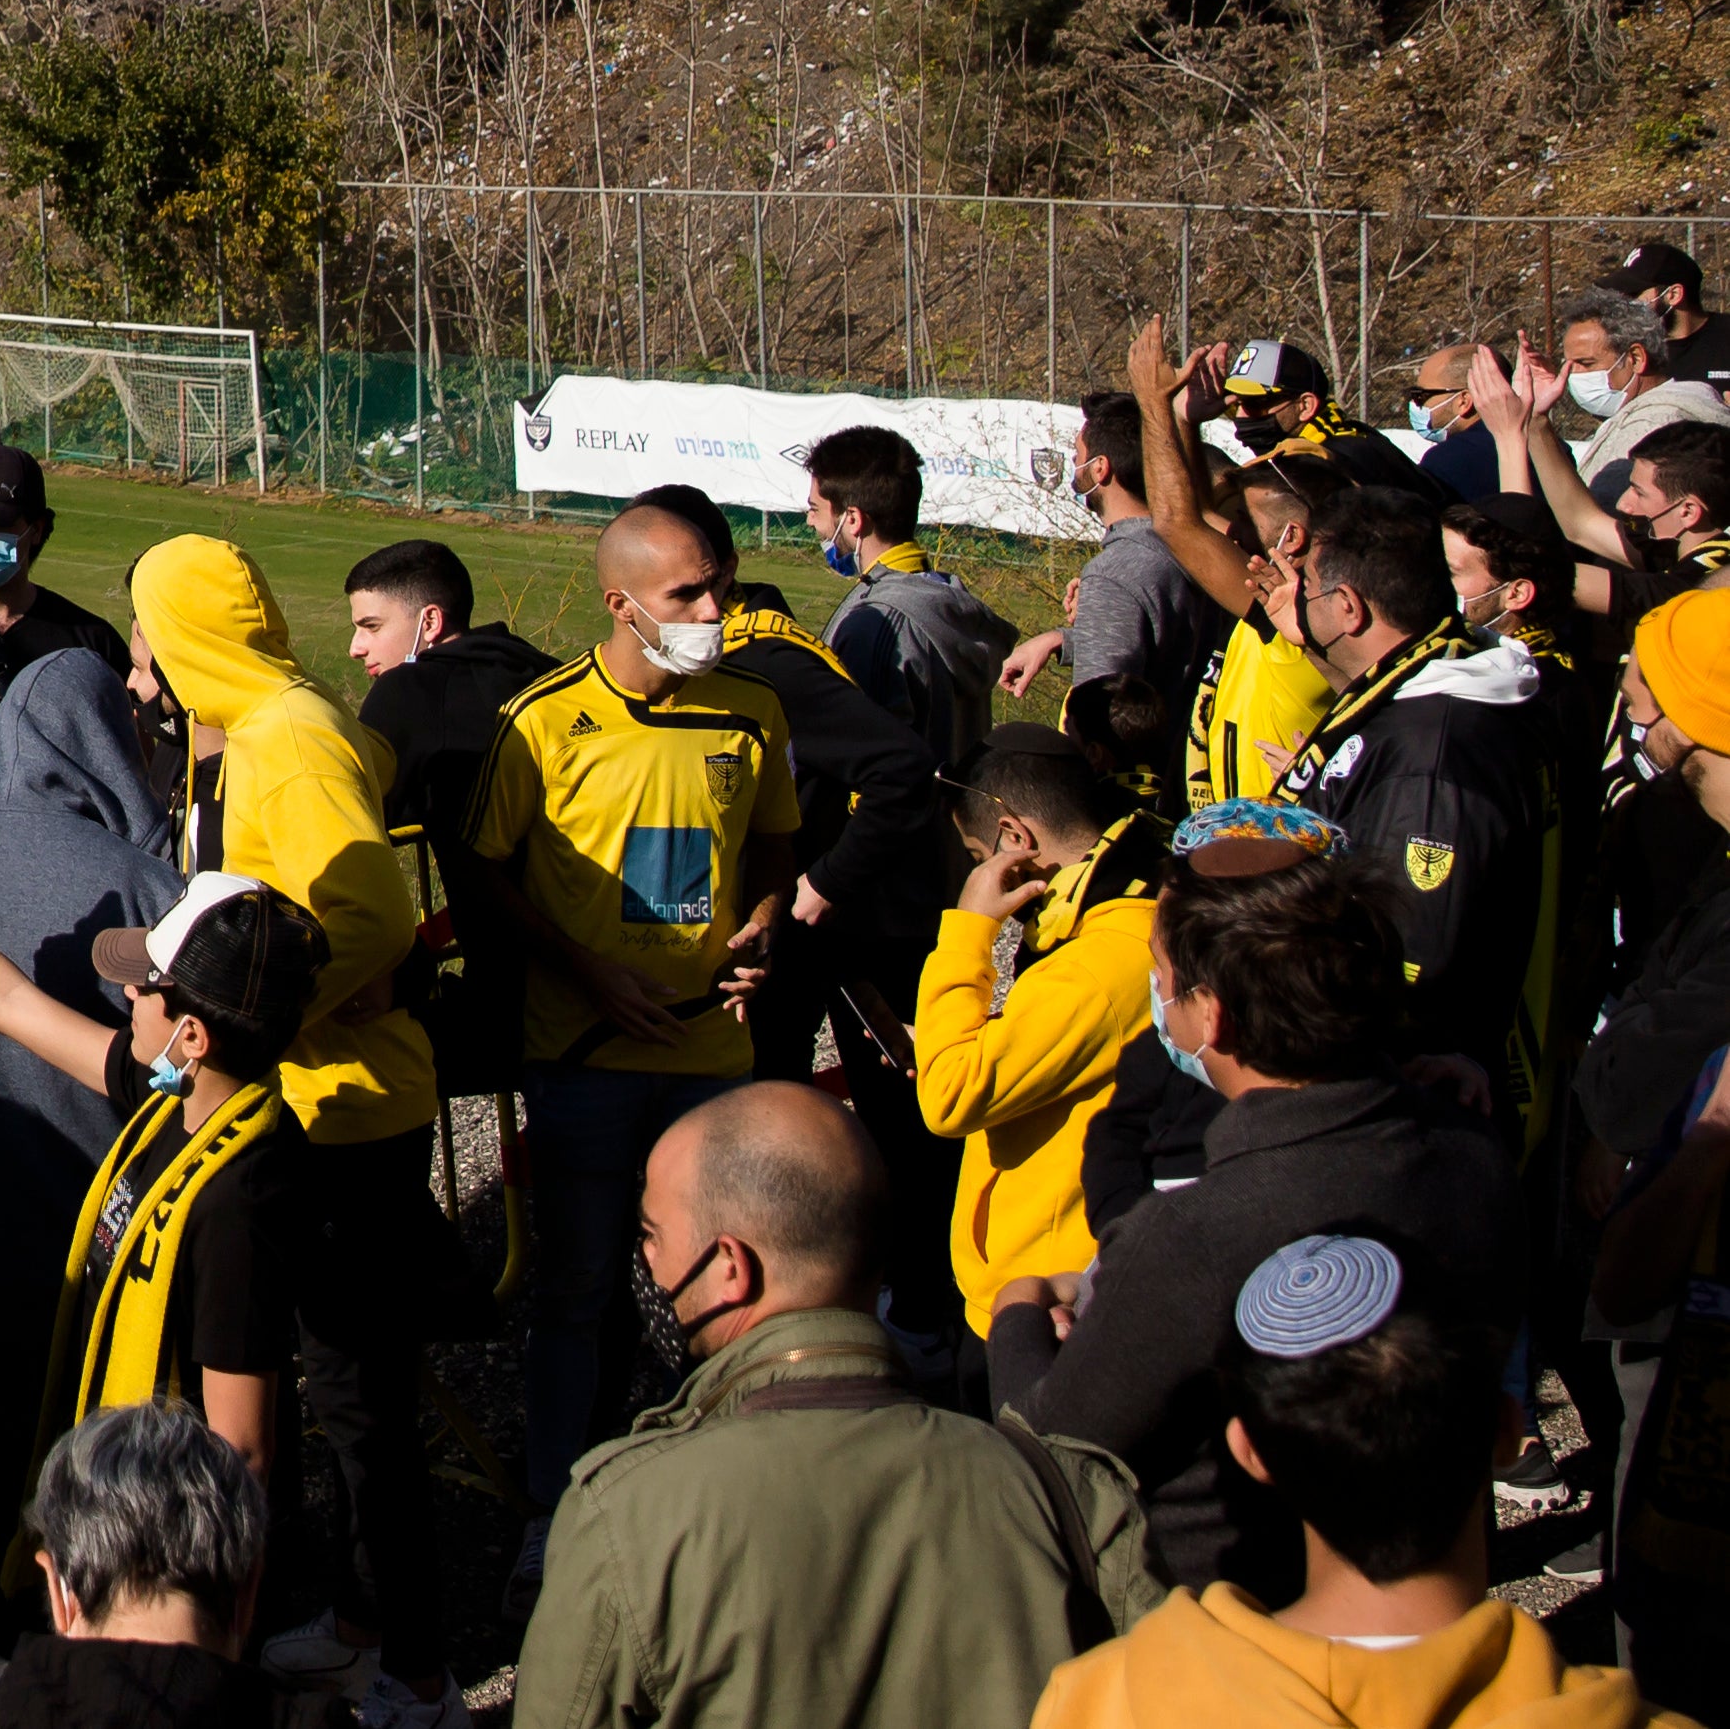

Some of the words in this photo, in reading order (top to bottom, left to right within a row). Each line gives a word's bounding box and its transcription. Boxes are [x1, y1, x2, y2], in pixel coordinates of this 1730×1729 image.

[575, 428, 650, 454] REPLAY
[674, 434, 725, 458] ספורט
[568, 724, 603, 738] adidas
